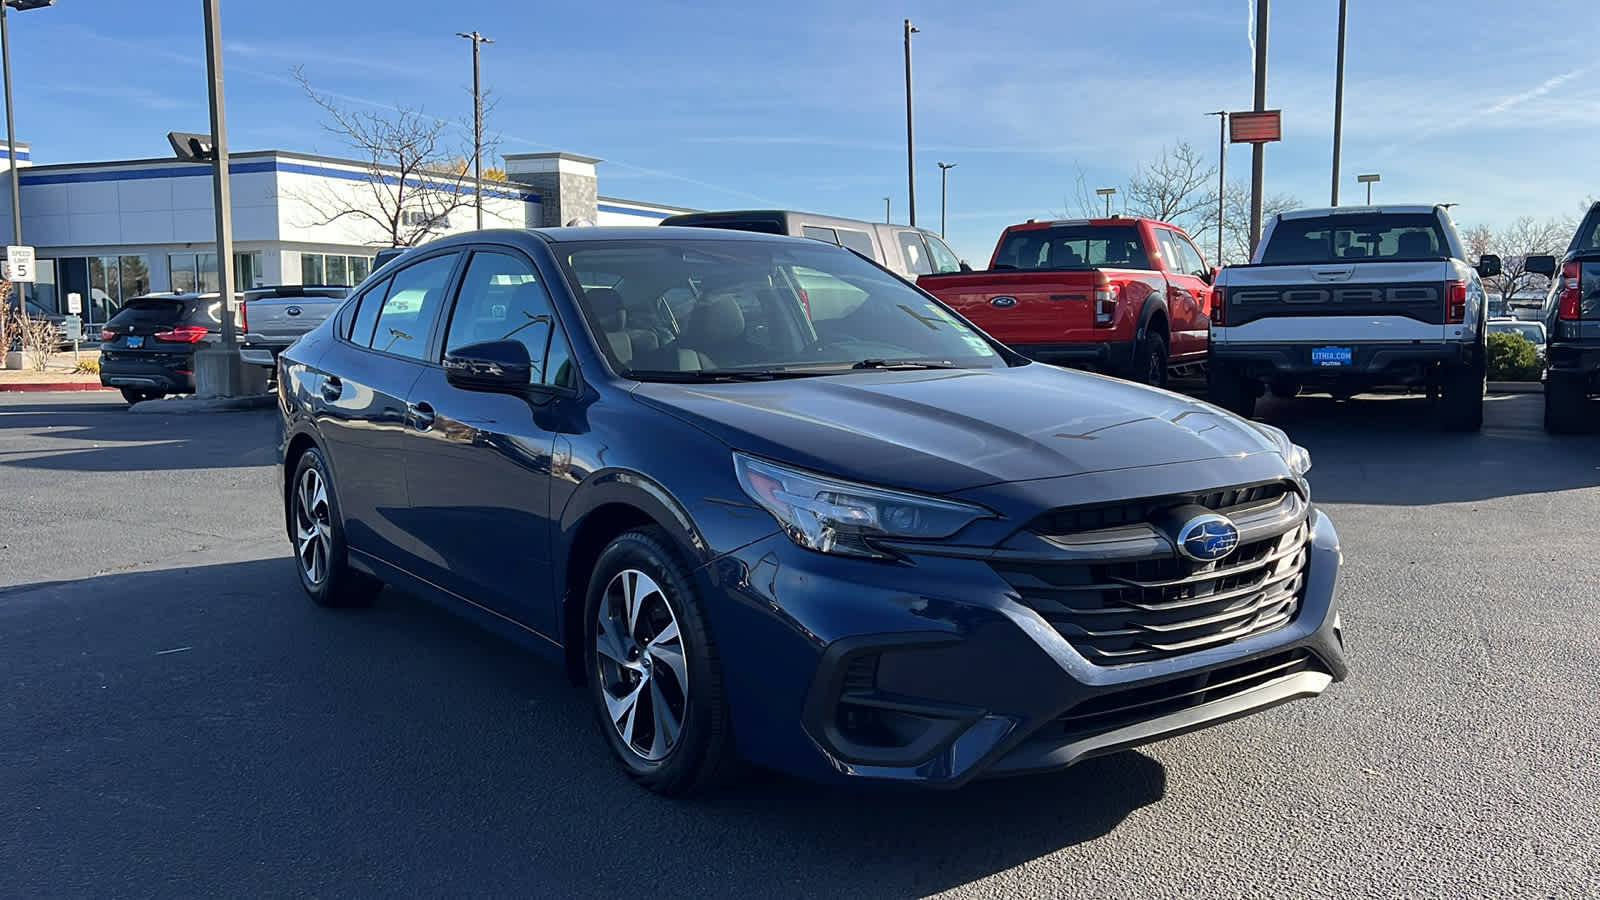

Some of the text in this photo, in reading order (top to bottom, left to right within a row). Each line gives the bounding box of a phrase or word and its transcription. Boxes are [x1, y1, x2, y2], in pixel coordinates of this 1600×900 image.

[17, 264, 27, 277] 5
[1232, 287, 1438, 305] FORD
[1311, 351, 1352, 361] LITHIA.COM
